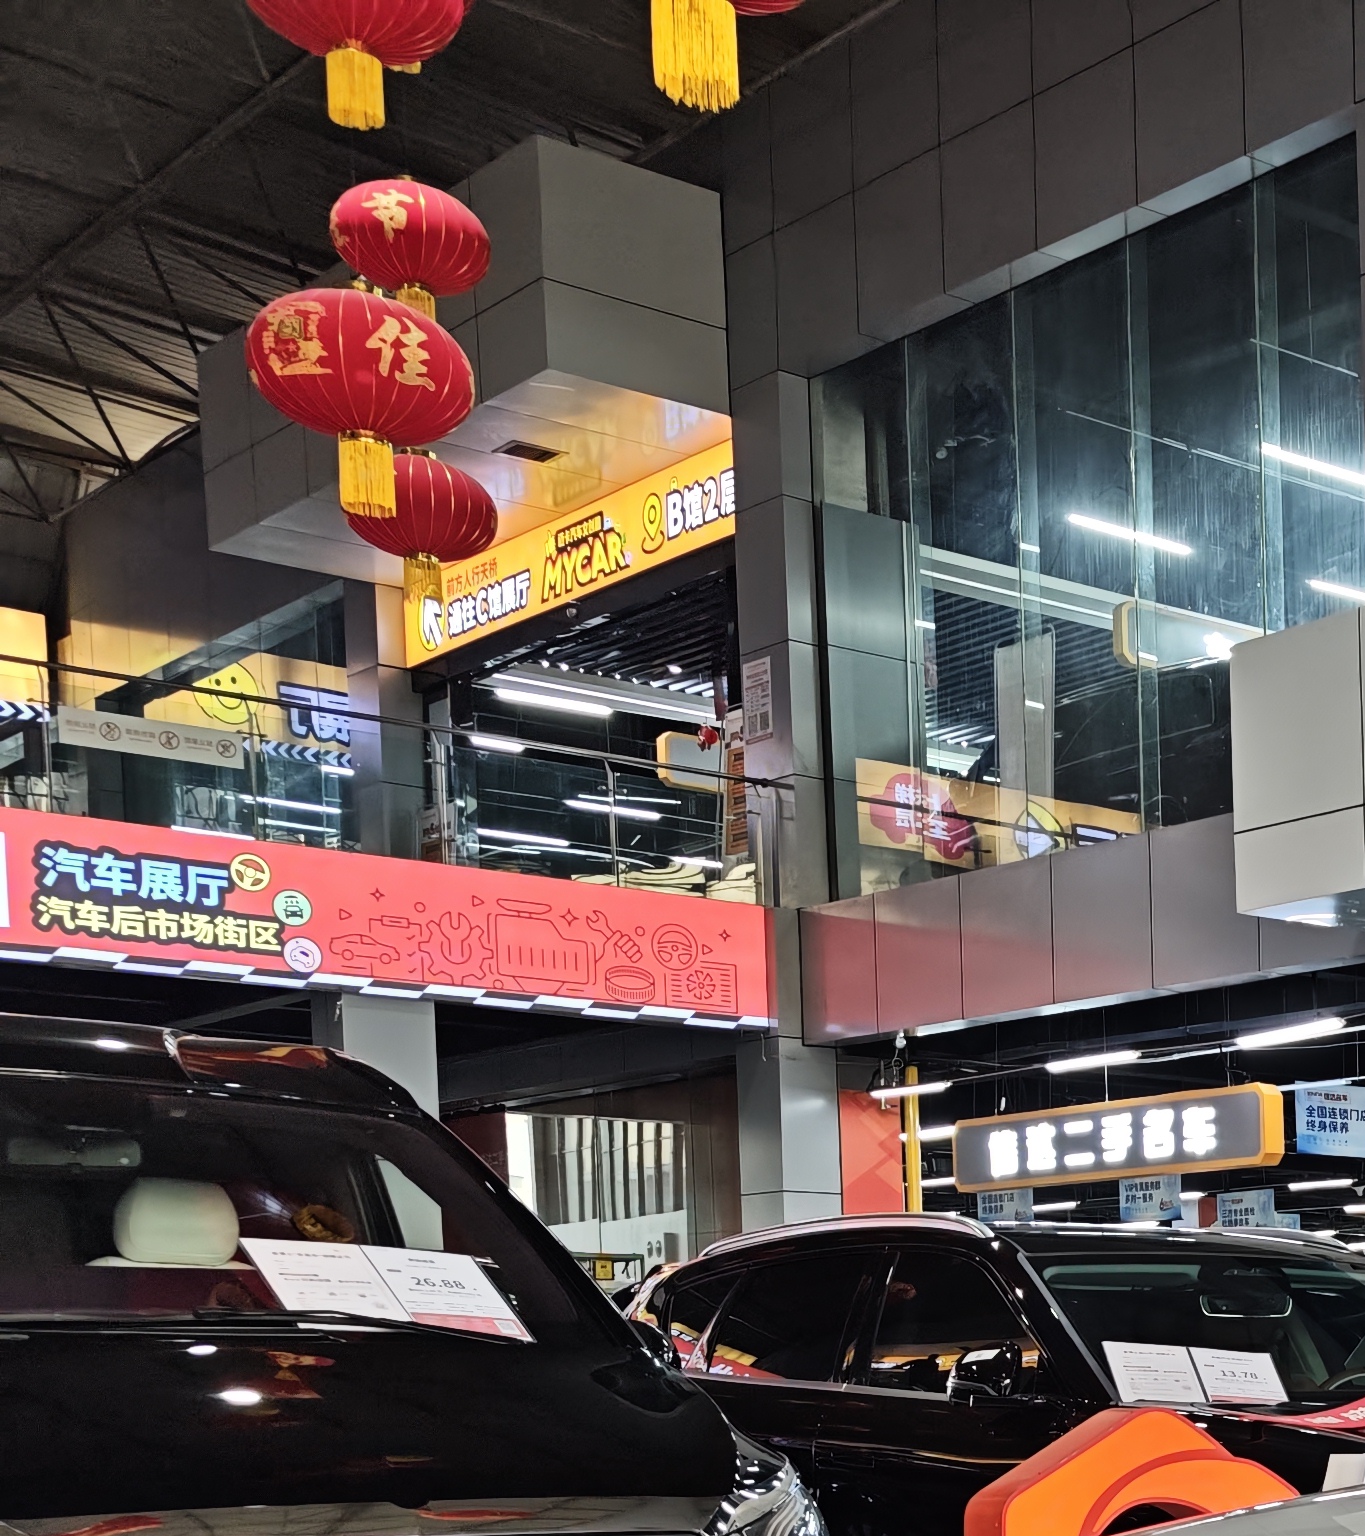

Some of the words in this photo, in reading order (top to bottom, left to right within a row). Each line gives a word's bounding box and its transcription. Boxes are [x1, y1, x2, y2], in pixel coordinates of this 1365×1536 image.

[446, 557, 497, 597] 前方人行天桥
[542, 529, 628, 603] MYCAR
[39, 845, 230, 906] 汽车展厅
[37, 895, 282, 951] 汽车后市场街区
[1306, 1119, 1349, 1134] 终身保养
[410, 1276, 466, 1290] 26.88
[1220, 1369, 1259, 1380] 13.78
